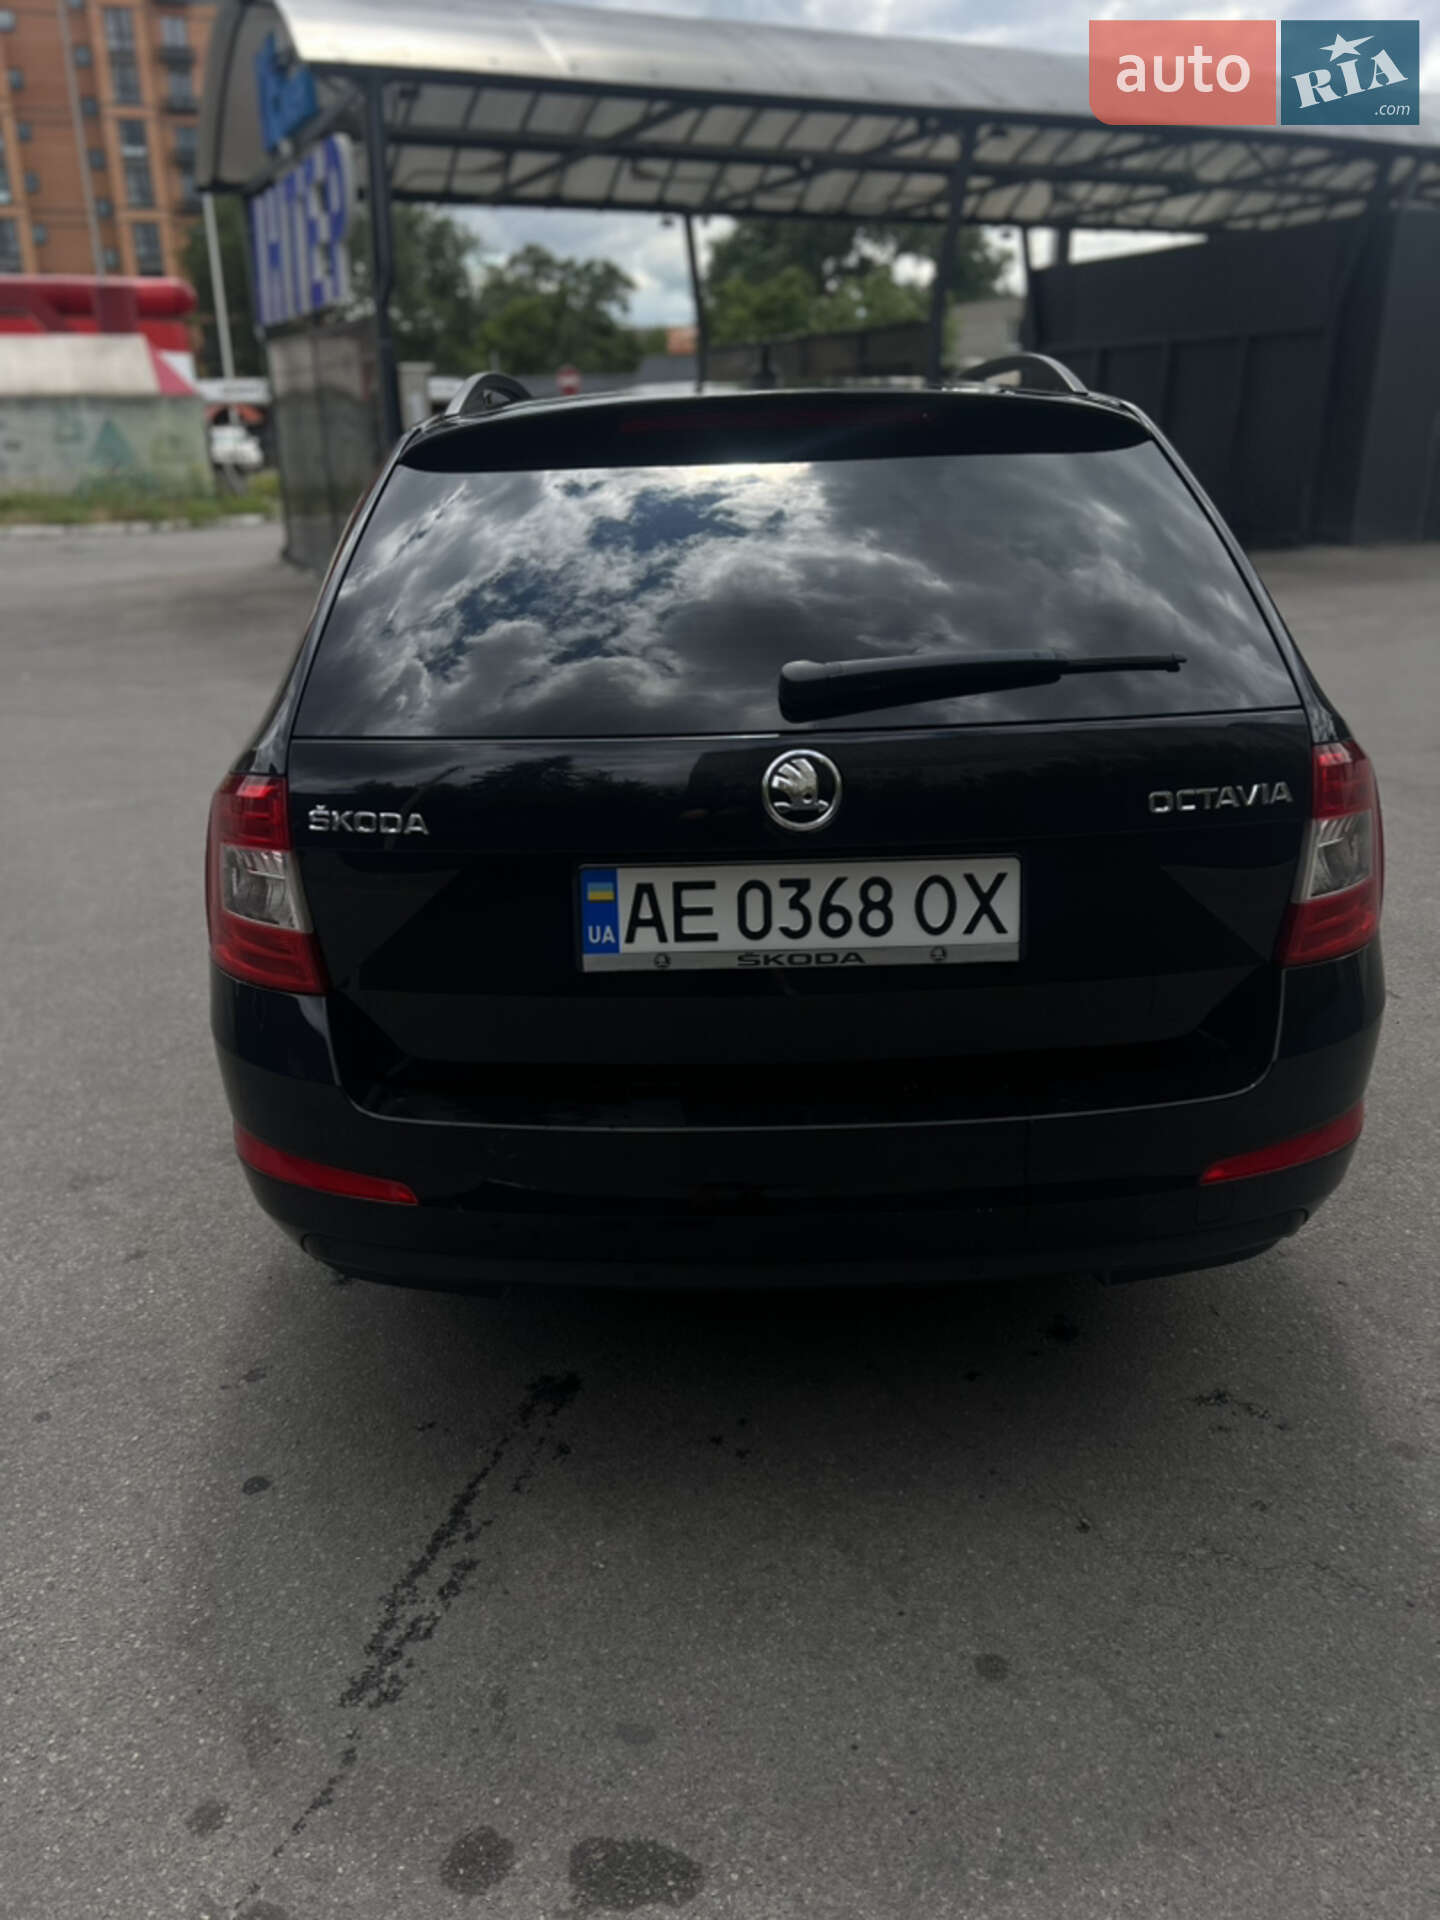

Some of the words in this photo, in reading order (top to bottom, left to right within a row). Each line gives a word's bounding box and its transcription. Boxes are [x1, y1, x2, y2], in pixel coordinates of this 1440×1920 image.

[1148, 781, 1294, 813] OCTAVIA
[308, 804, 429, 835] ŠKODA
[624, 880, 719, 944] AE
[736, 876, 895, 941] 0368
[914, 872, 1009, 936] OX
[588, 925, 616, 944] UA
[737, 951, 865, 967] ŠKODA
